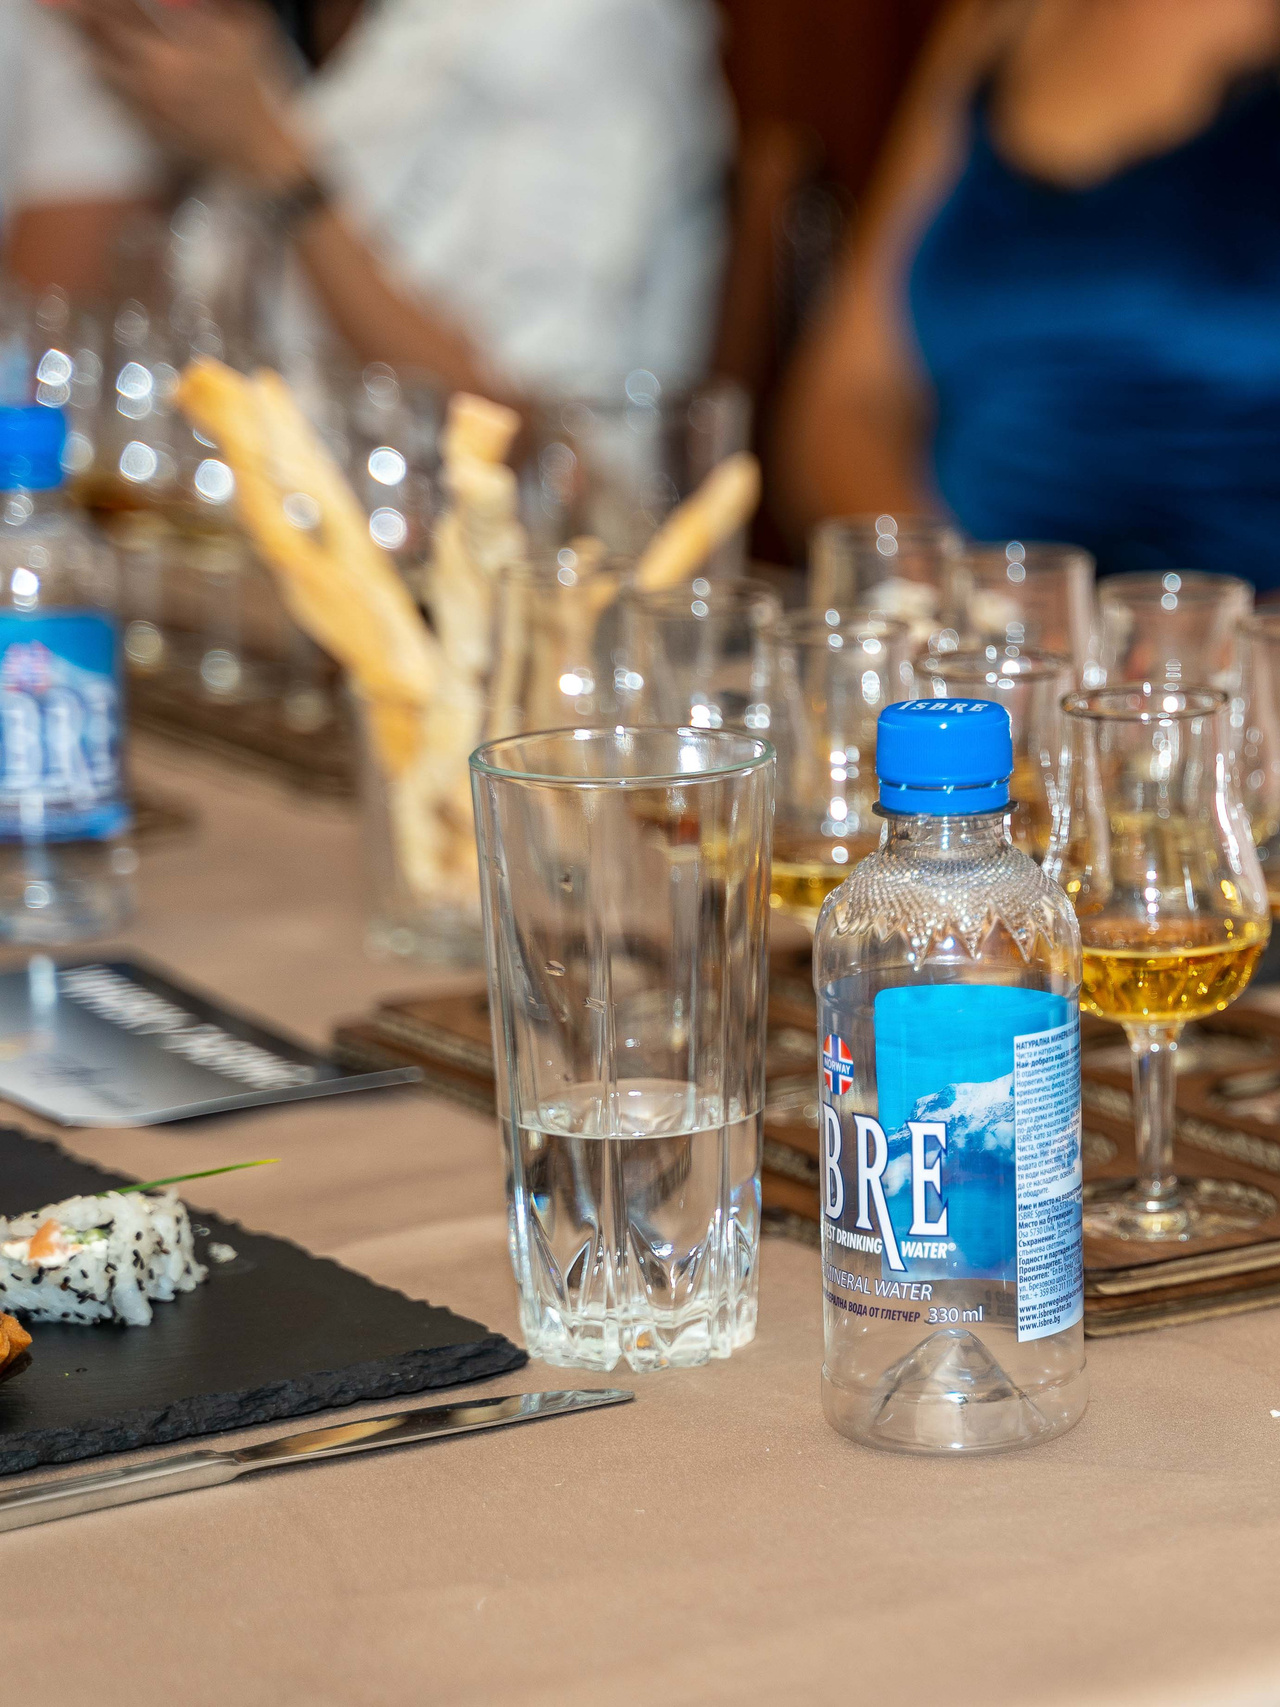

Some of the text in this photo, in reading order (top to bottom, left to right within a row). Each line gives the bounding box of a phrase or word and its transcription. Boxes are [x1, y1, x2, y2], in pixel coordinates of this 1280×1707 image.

[898, 700, 989, 713] ISBRE
[823, 1056, 851, 1076] NORWAY
[1017, 1220, 1039, 1230] Място
[836, 1229, 883, 1254] DRINKING
[1018, 1232, 1057, 1249] Съхранение:
[1018, 1253, 1044, 1267] Годност
[1018, 1257, 1063, 1276] Производител:
[1018, 1270, 1050, 1284] Вносител:
[873, 1278, 934, 1301] WATER
[847, 1301, 868, 1317] ВОДА
[868, 1306, 881, 1319] ОТ
[880, 1308, 921, 1323] ГЛЕТЧЕР
[928, 1305, 984, 1323] 330 ml
[1018, 1301, 1073, 1323] www.isbrewater.no
[1018, 1314, 1061, 1332] www.isbre.bg
